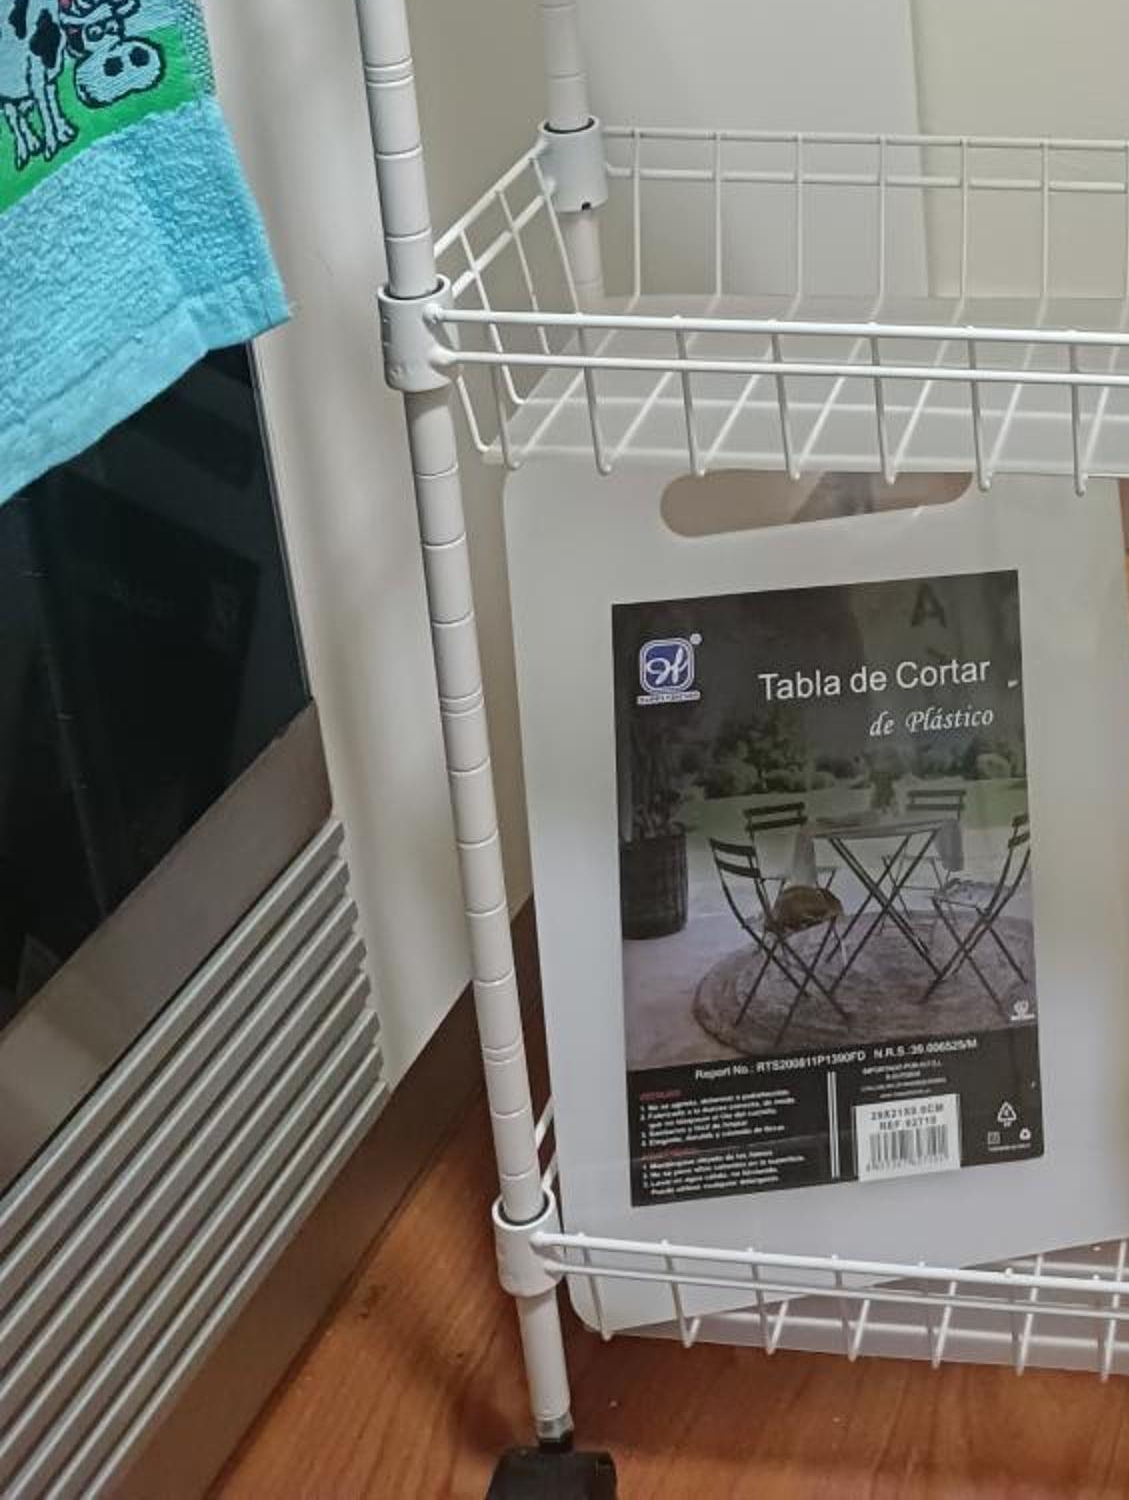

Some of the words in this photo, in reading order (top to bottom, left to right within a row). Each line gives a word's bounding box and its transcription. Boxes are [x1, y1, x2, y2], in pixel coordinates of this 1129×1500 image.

[758, 668, 841, 701] Tabla
[850, 665, 888, 693] de
[896, 659, 991, 690] Cortar
[869, 711, 895, 737] de
[905, 703, 994, 734] Plástico
